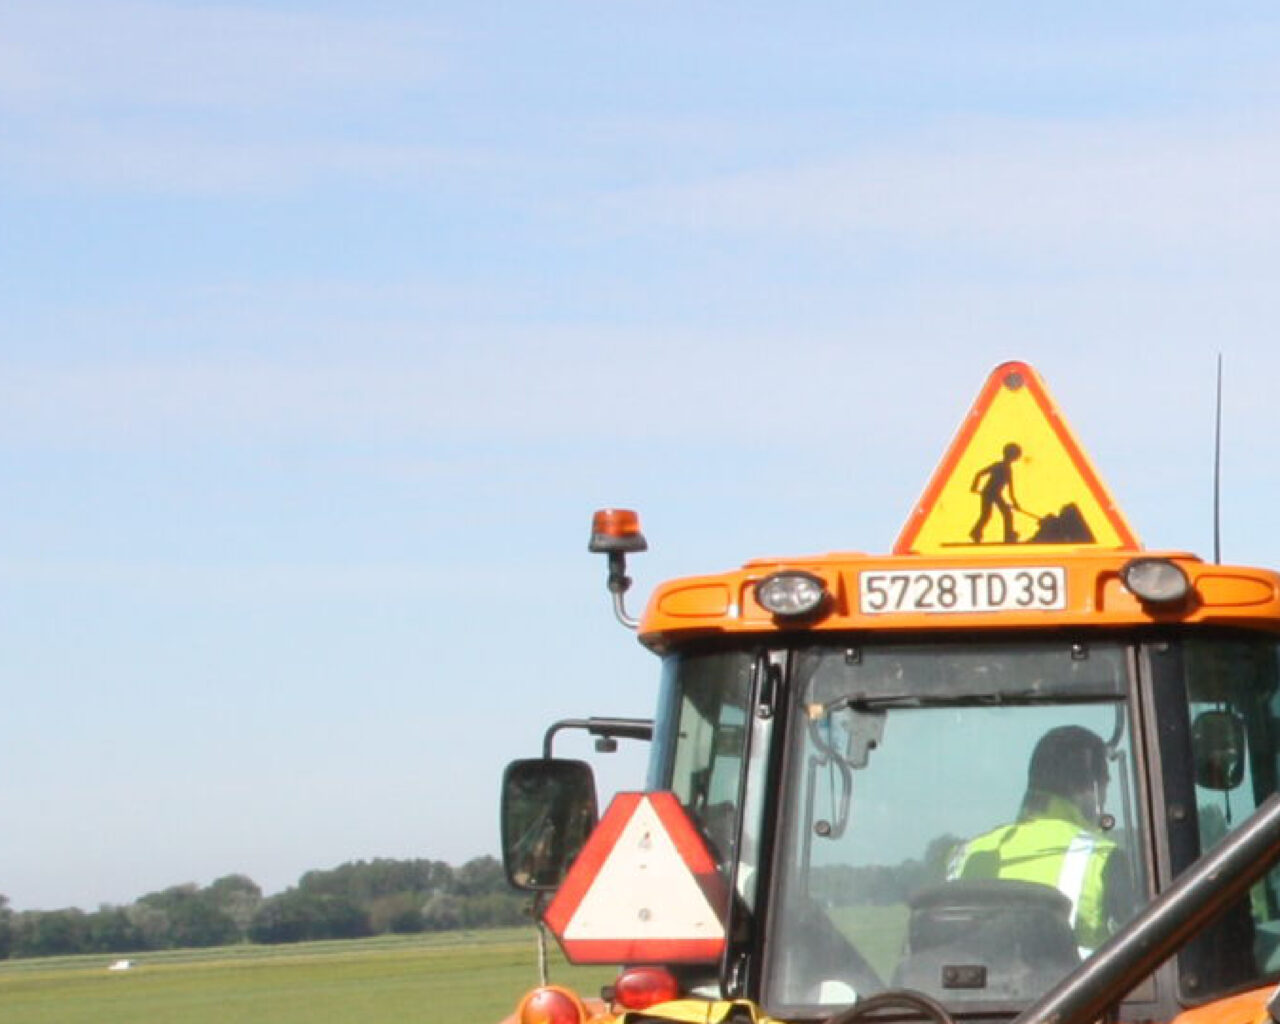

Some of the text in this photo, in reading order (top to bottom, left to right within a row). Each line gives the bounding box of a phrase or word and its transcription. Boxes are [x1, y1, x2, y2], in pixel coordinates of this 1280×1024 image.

[866, 571, 1058, 610] 5728 TD 39
